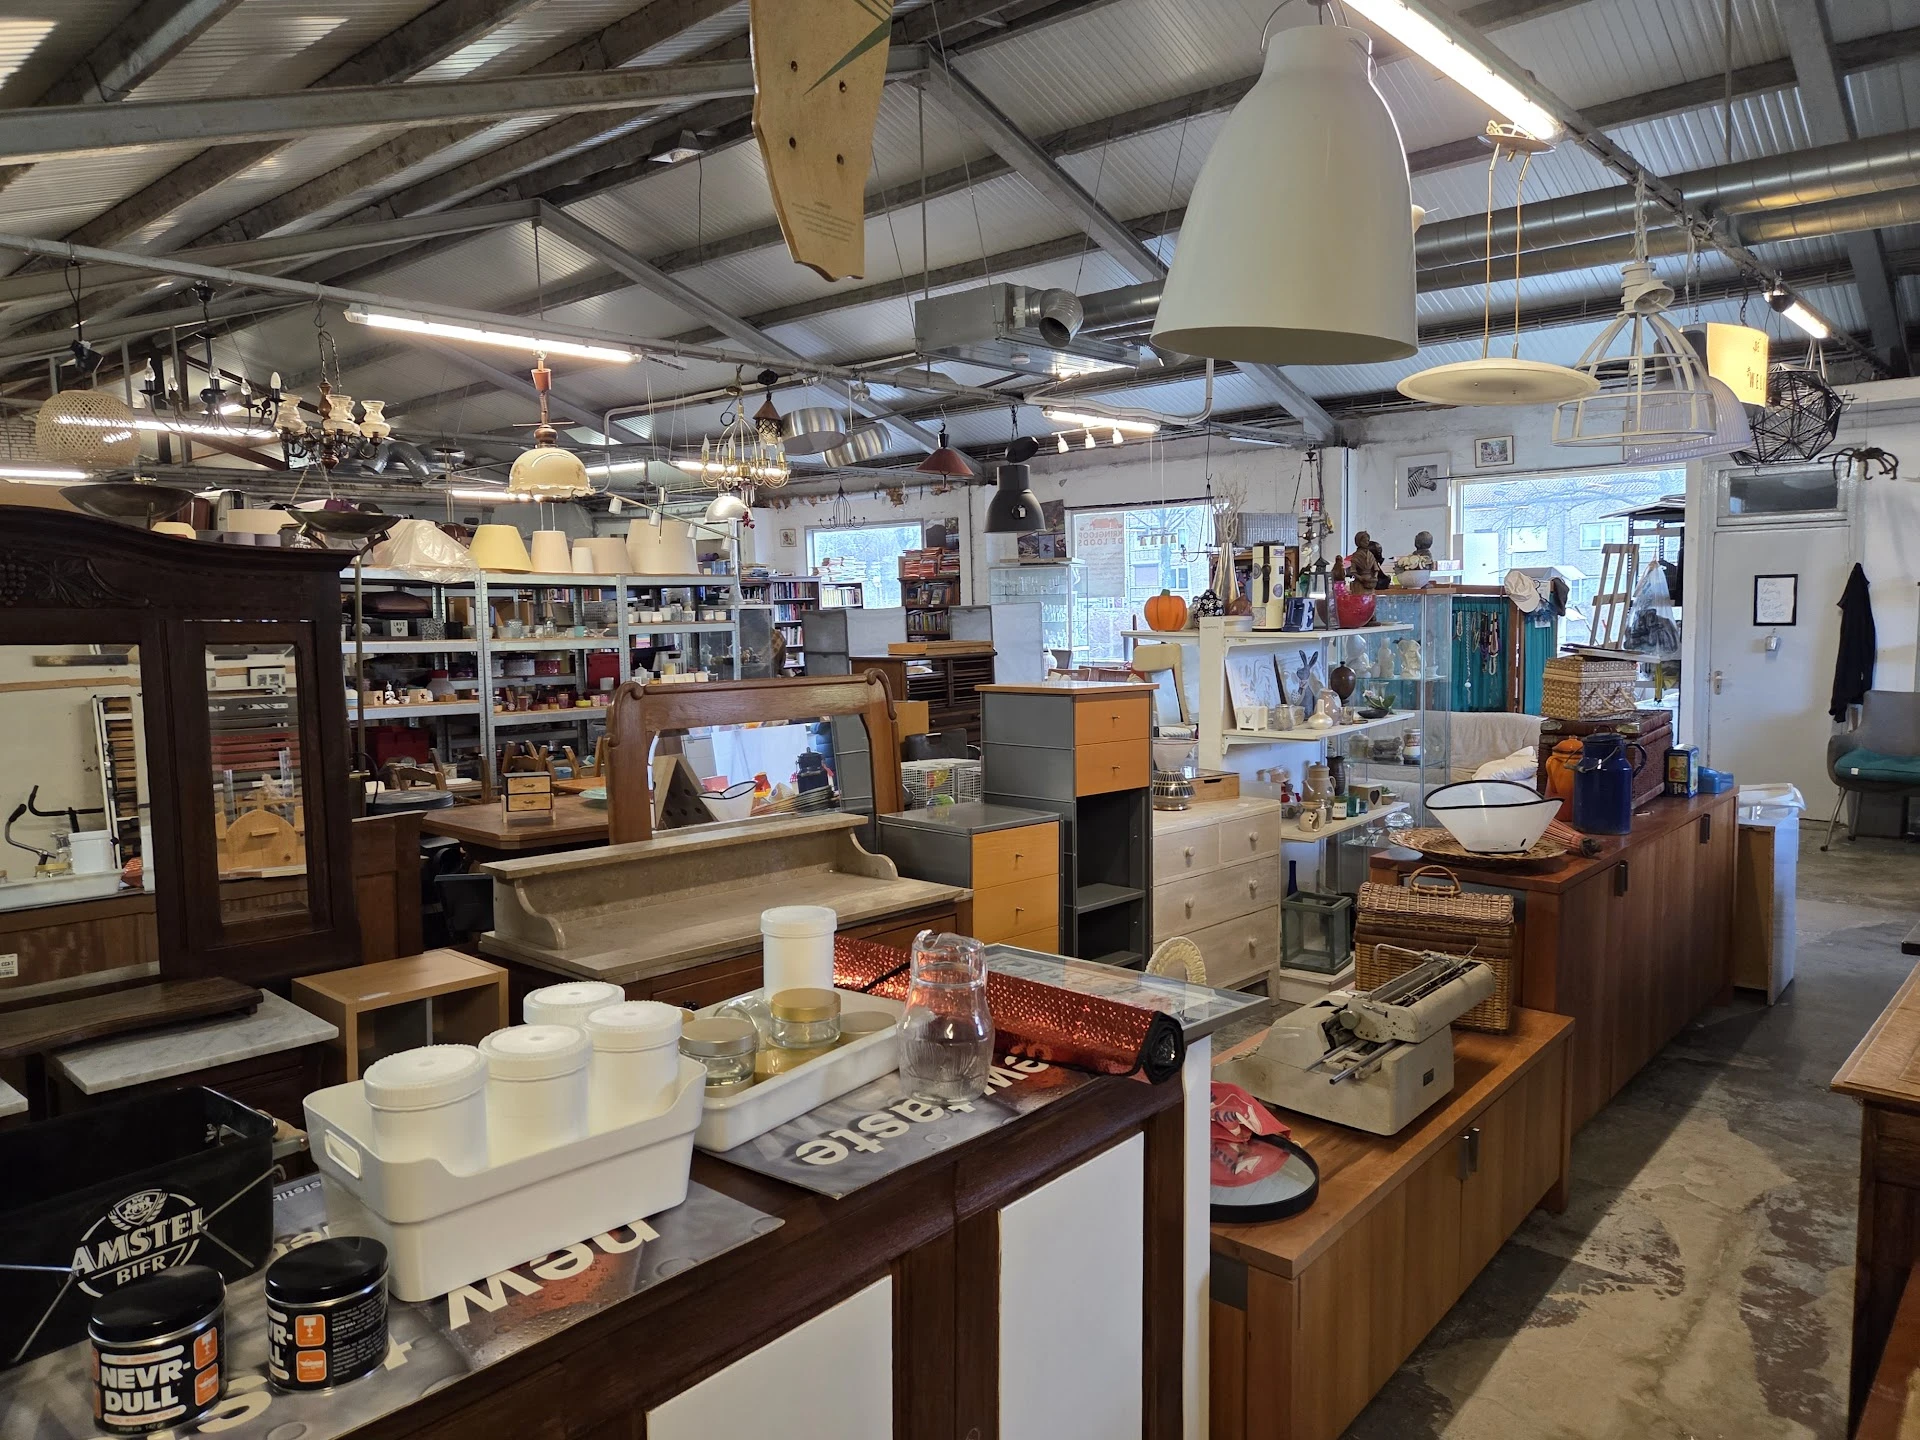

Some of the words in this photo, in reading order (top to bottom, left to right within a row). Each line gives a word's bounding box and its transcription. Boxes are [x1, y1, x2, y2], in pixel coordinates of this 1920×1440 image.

[71, 1207, 208, 1275] AMSTEL
[447, 1219, 661, 1331] new
[101, 1359, 191, 1389] NEVR-
[105, 1385, 179, 1413] DULL
